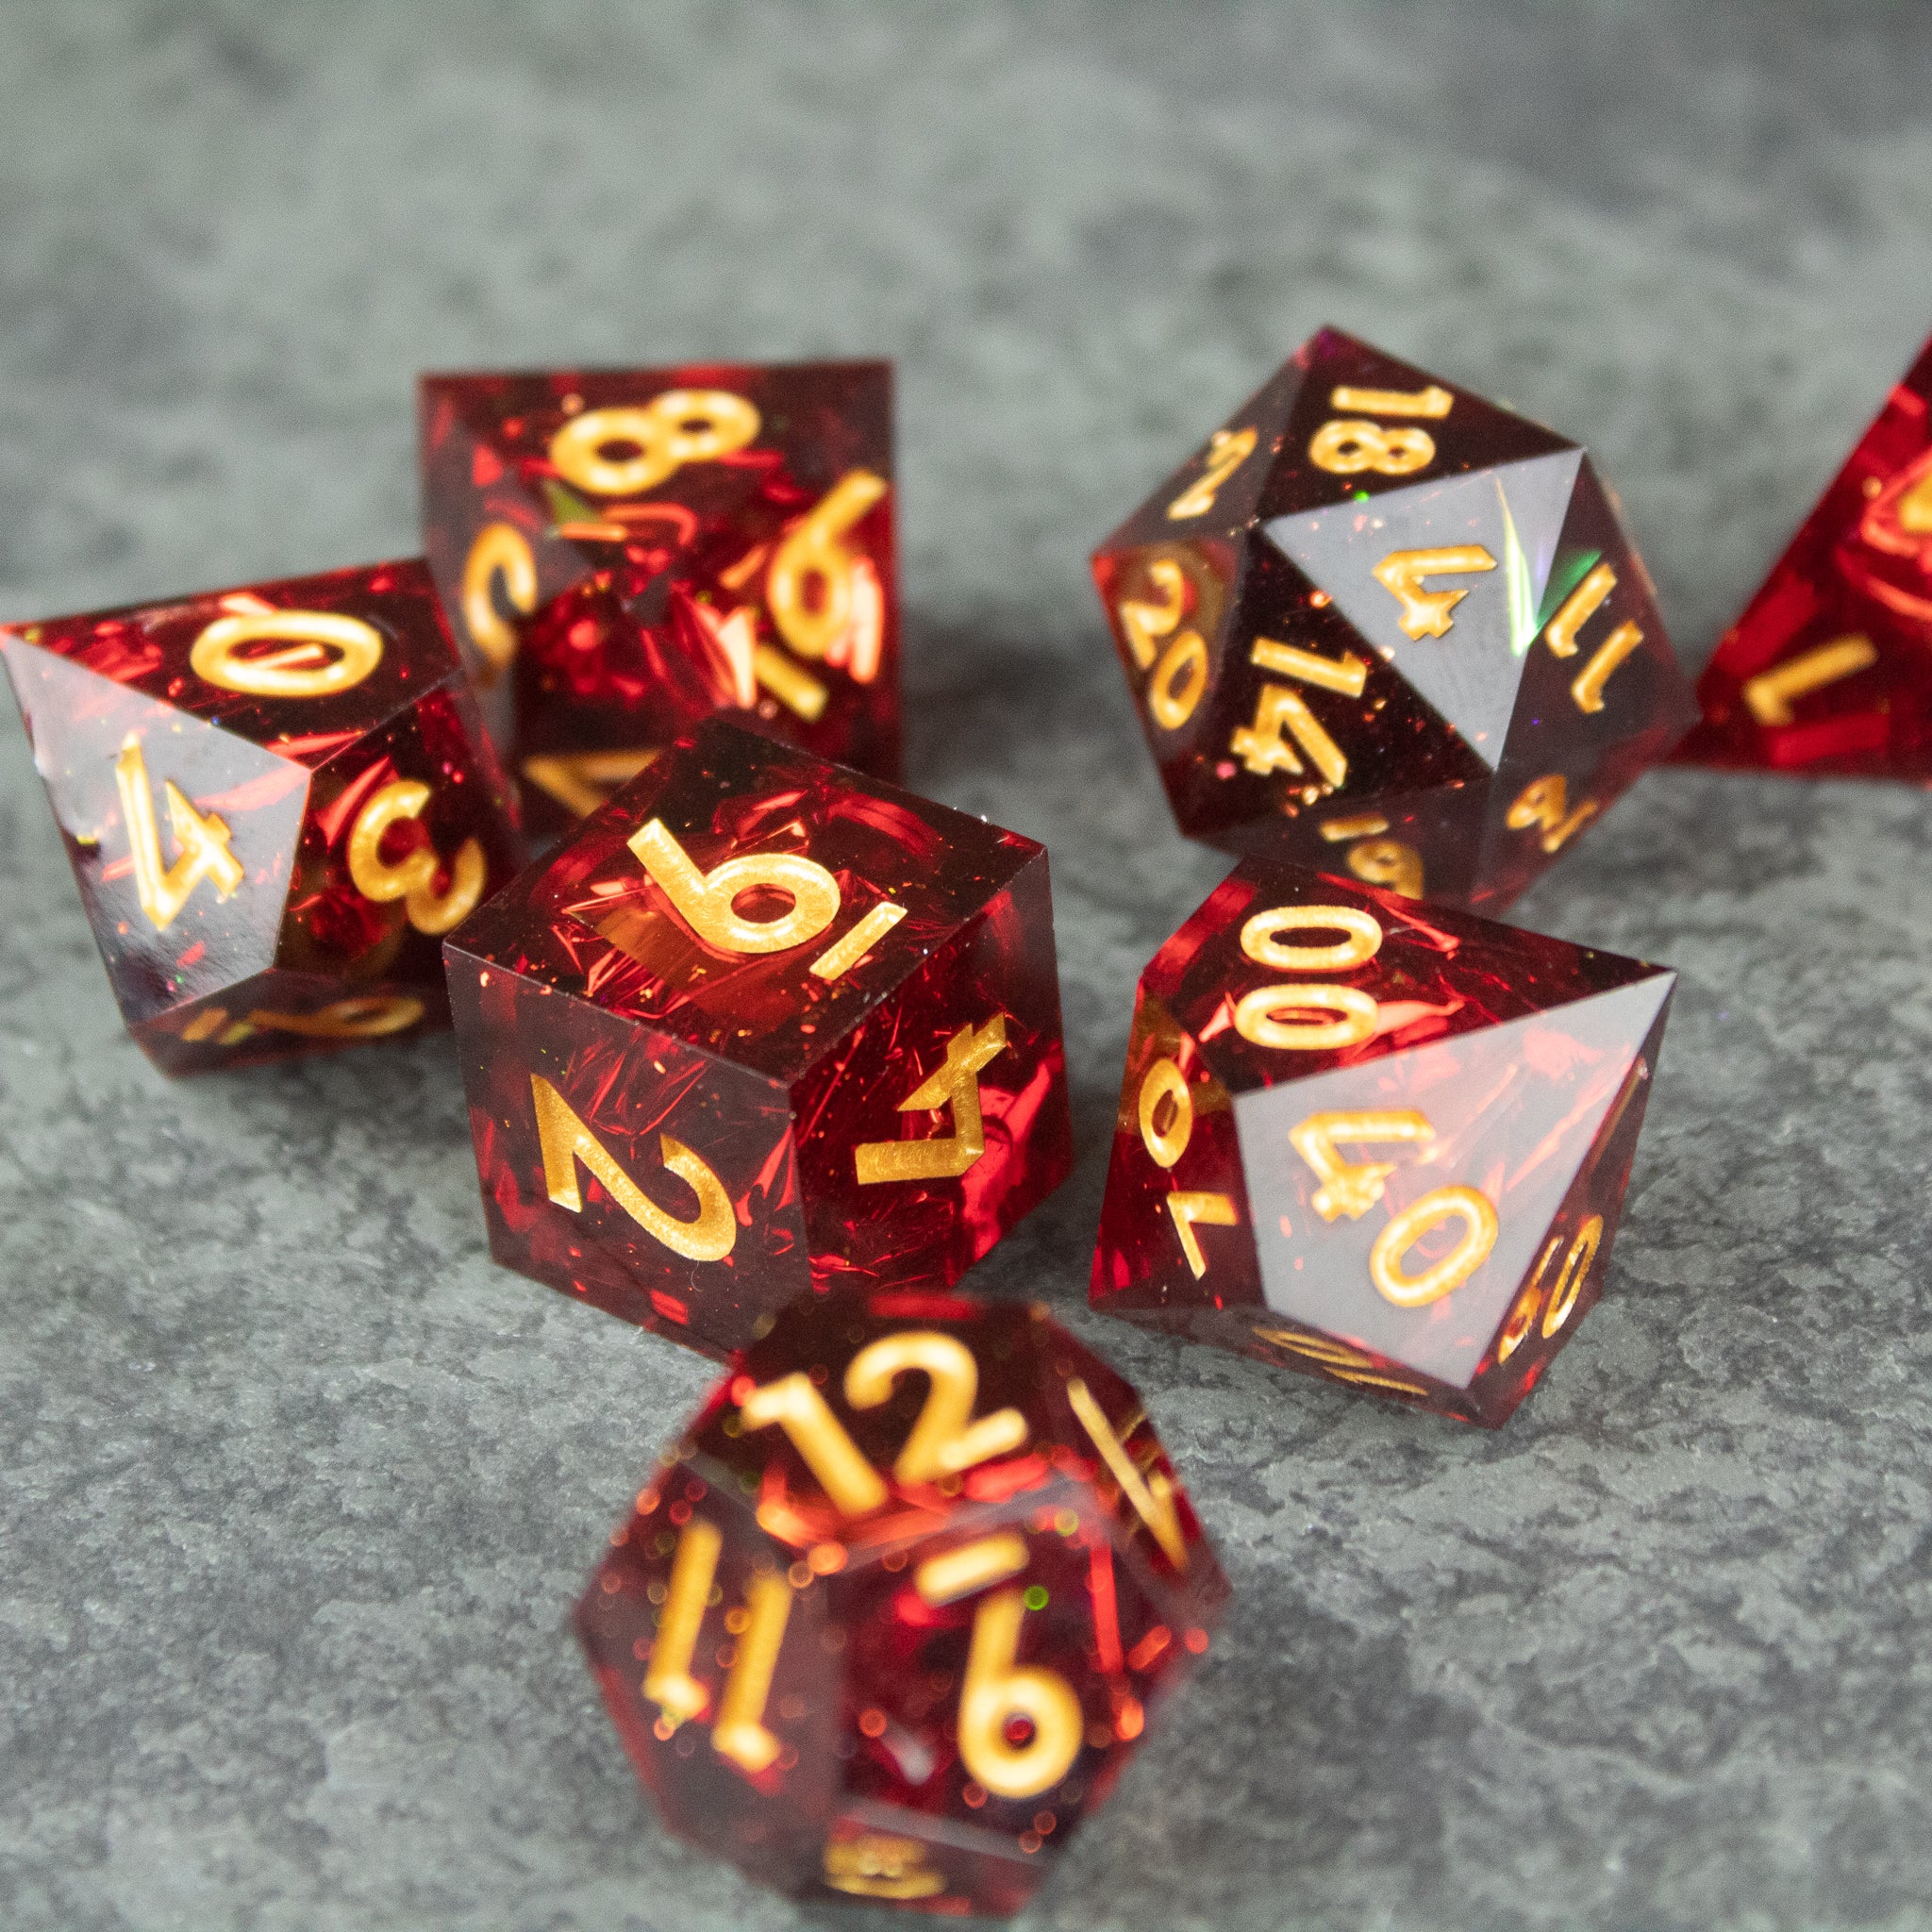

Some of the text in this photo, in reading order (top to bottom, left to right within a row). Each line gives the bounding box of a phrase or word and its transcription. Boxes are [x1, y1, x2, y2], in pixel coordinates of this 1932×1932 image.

[547, 390, 762, 496] 8
[1309, 386, 1455, 475] 18
[191, 609, 385, 698] 0
[1120, 559, 1209, 731] 20
[1374, 545, 1497, 641] 4
[1545, 563, 1643, 714] 11
[1231, 638, 1368, 791] 14
[115, 733, 243, 932] 4
[348, 779, 487, 936] 3
[1234, 905, 1384, 1051] 00
[530, 1074, 737, 1263] 2
[855, 1012, 1007, 1186] 4
[1289, 1110, 1498, 1308] 40
[736, 1331, 1030, 1516] 12
[643, 1519, 794, 1774] 11
